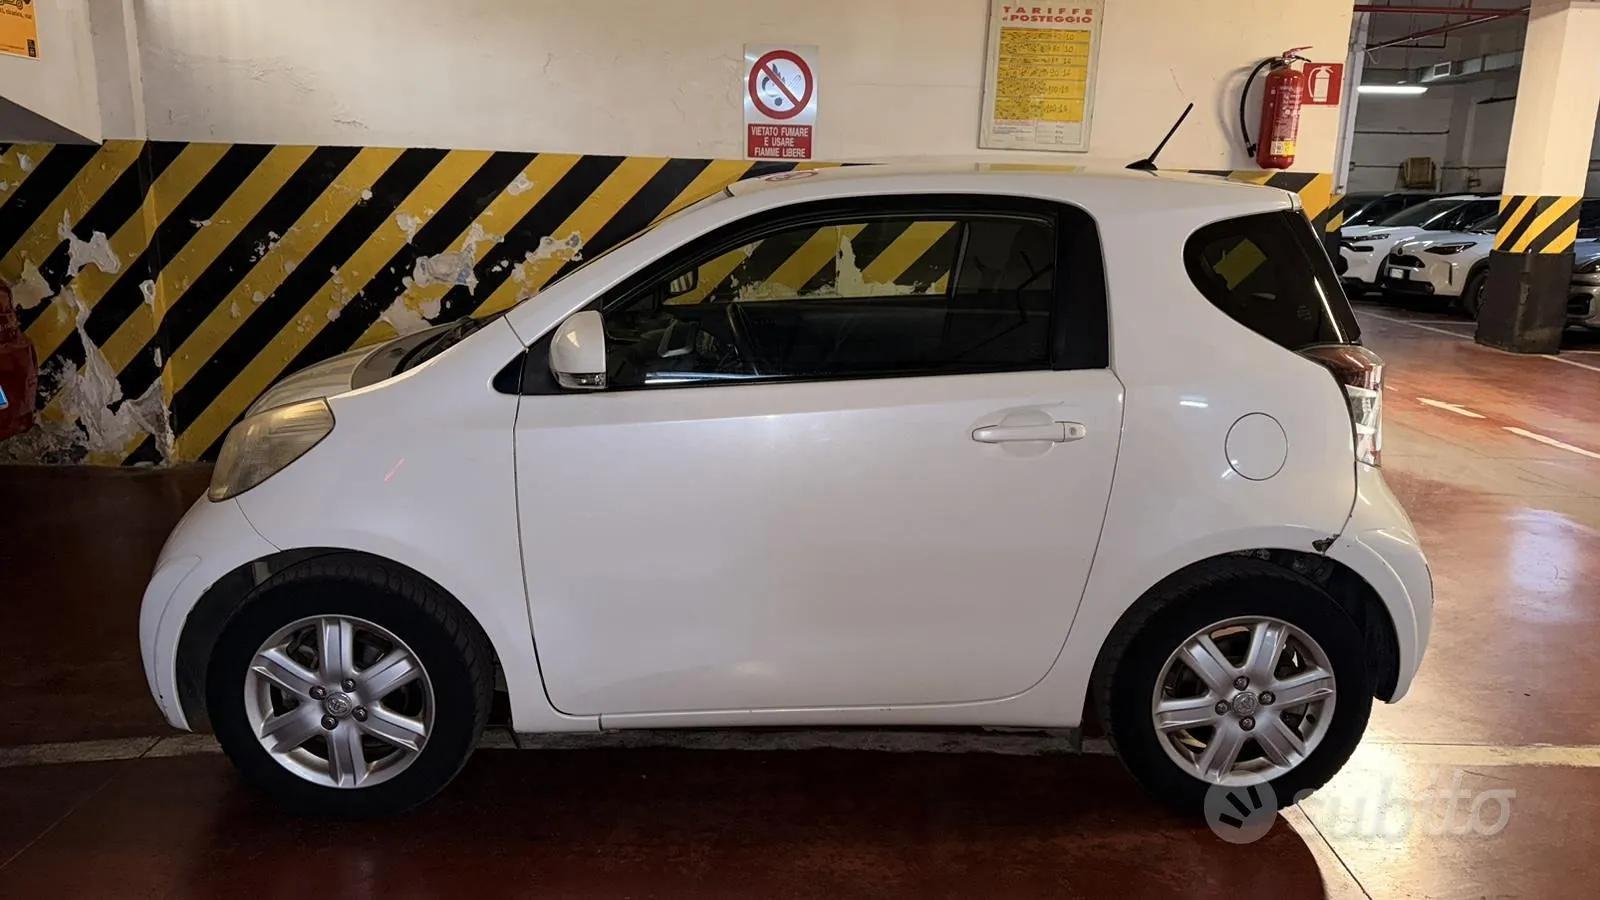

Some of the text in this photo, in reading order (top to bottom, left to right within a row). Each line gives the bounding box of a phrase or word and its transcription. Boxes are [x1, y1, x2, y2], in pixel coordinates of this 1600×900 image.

[1003, 6, 1093, 15] TARIFFE
[1010, 14, 1092, 24] POSTEGGIO
[751, 126, 809, 137] VIETATO FUMARE
[764, 137, 795, 147] E USARE
[754, 147, 806, 158] FIAMME LIBERE
